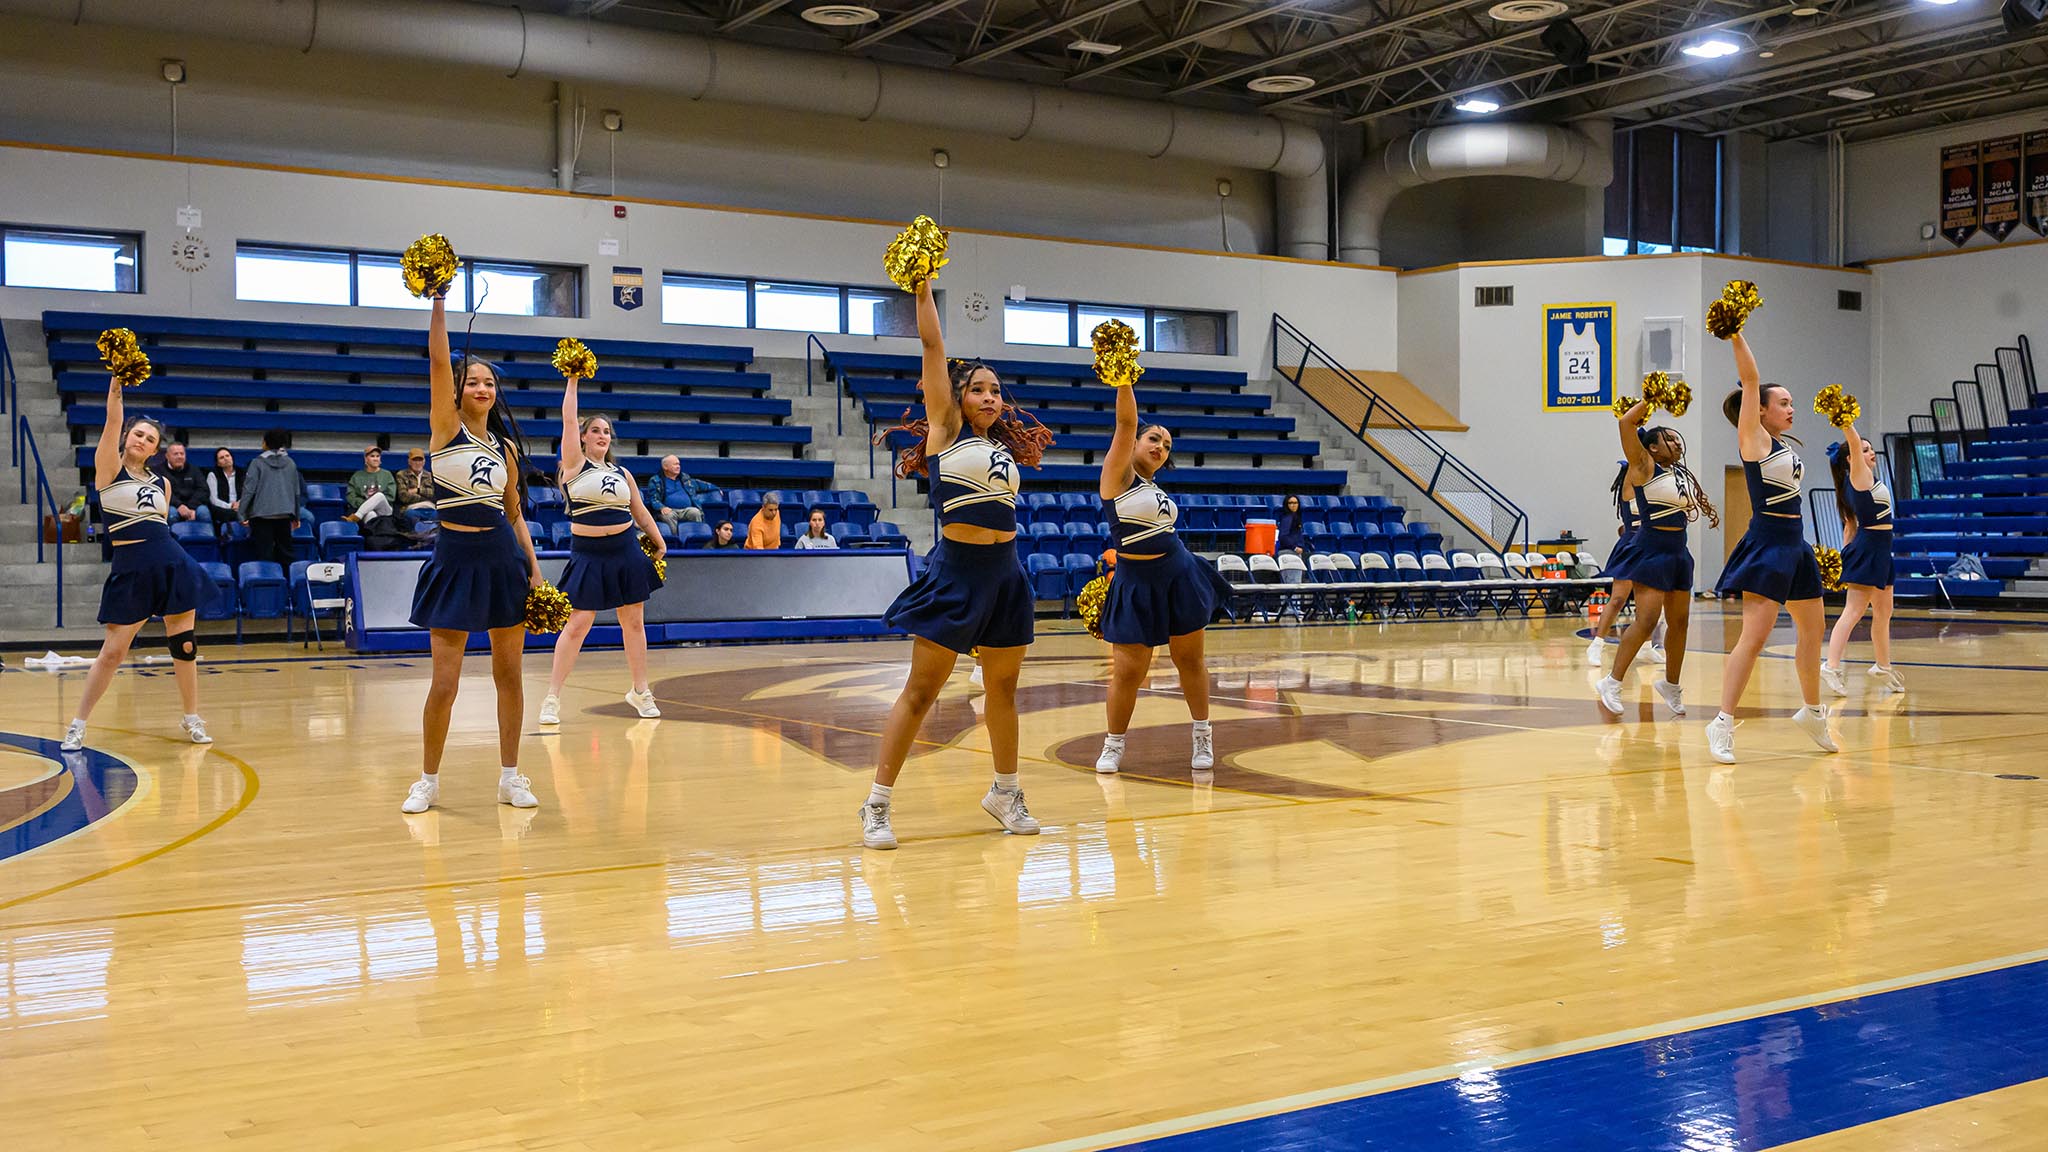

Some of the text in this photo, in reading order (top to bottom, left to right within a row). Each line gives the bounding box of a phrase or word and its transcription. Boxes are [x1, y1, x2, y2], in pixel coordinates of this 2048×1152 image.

[1992, 180, 2011, 190] 2010
[1989, 188, 2014, 197] NCAA
[1948, 194, 1973, 203] NCAA
[1550, 311, 1608, 320] JAMIE ROBERTS
[1568, 358, 1590, 374] 24
[1557, 396, 1600, 404] 2007-2011
